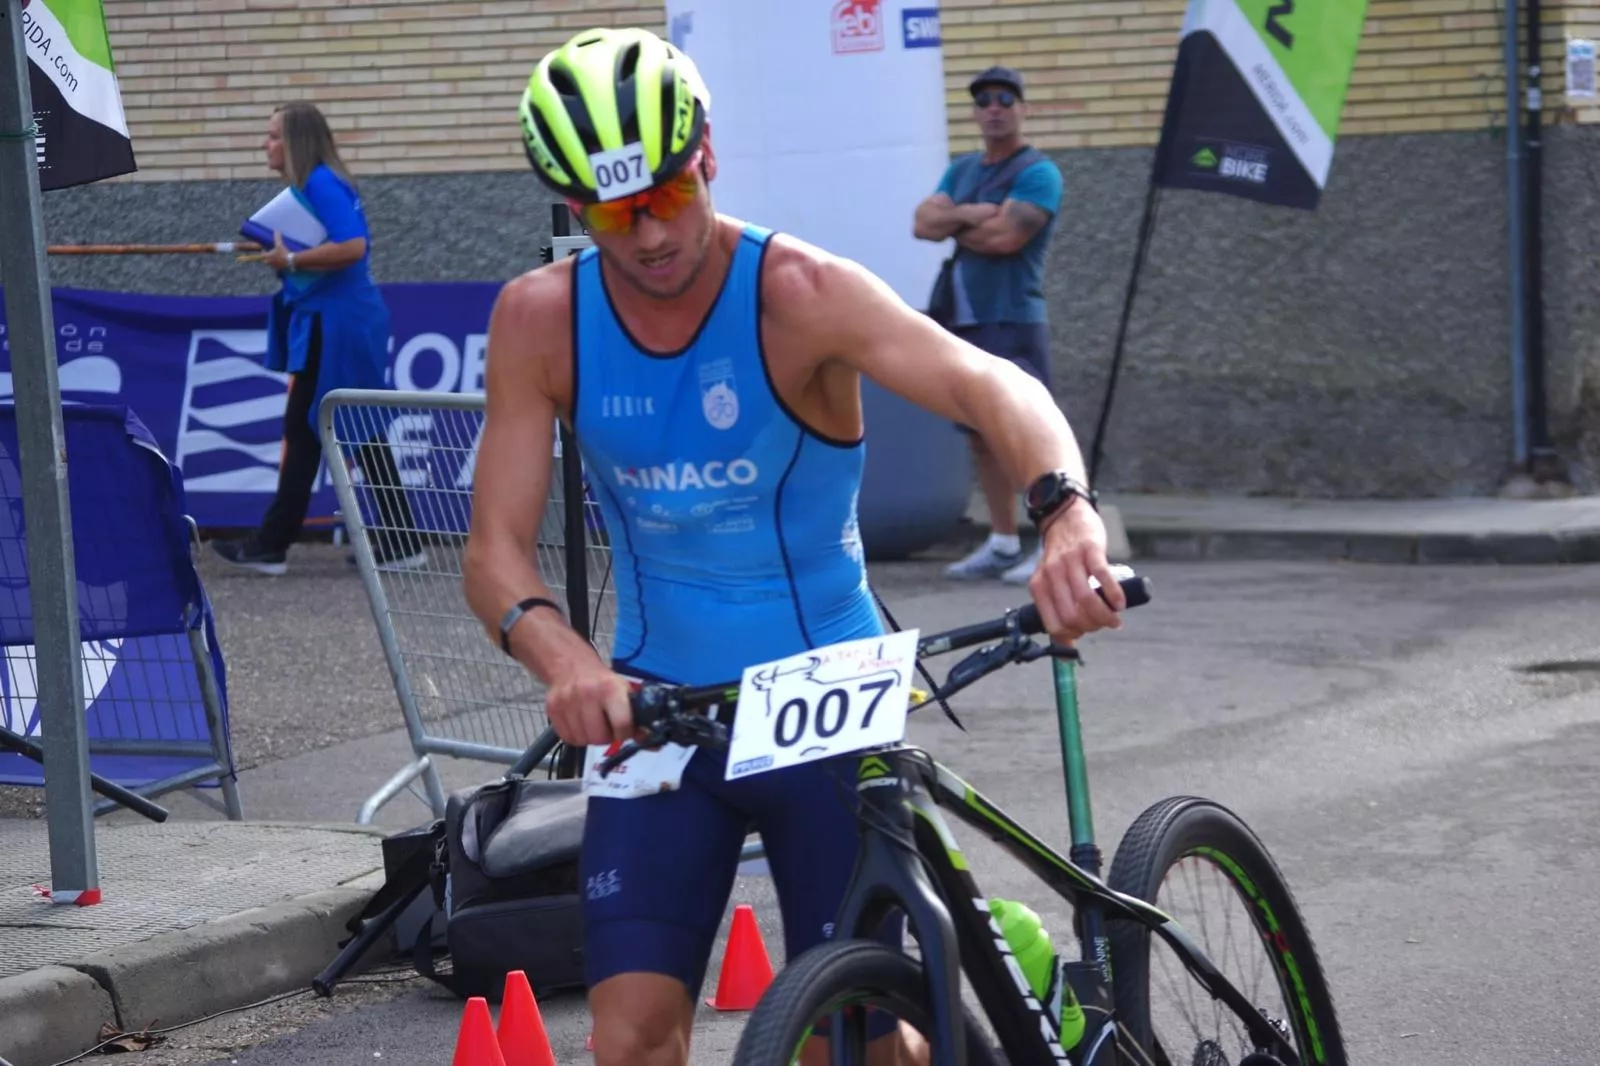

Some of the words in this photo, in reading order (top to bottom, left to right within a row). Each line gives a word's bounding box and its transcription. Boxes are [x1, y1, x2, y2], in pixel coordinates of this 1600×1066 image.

[595, 153, 645, 188] 007
[1219, 157, 1269, 183] BIKE
[773, 678, 896, 748] 007
